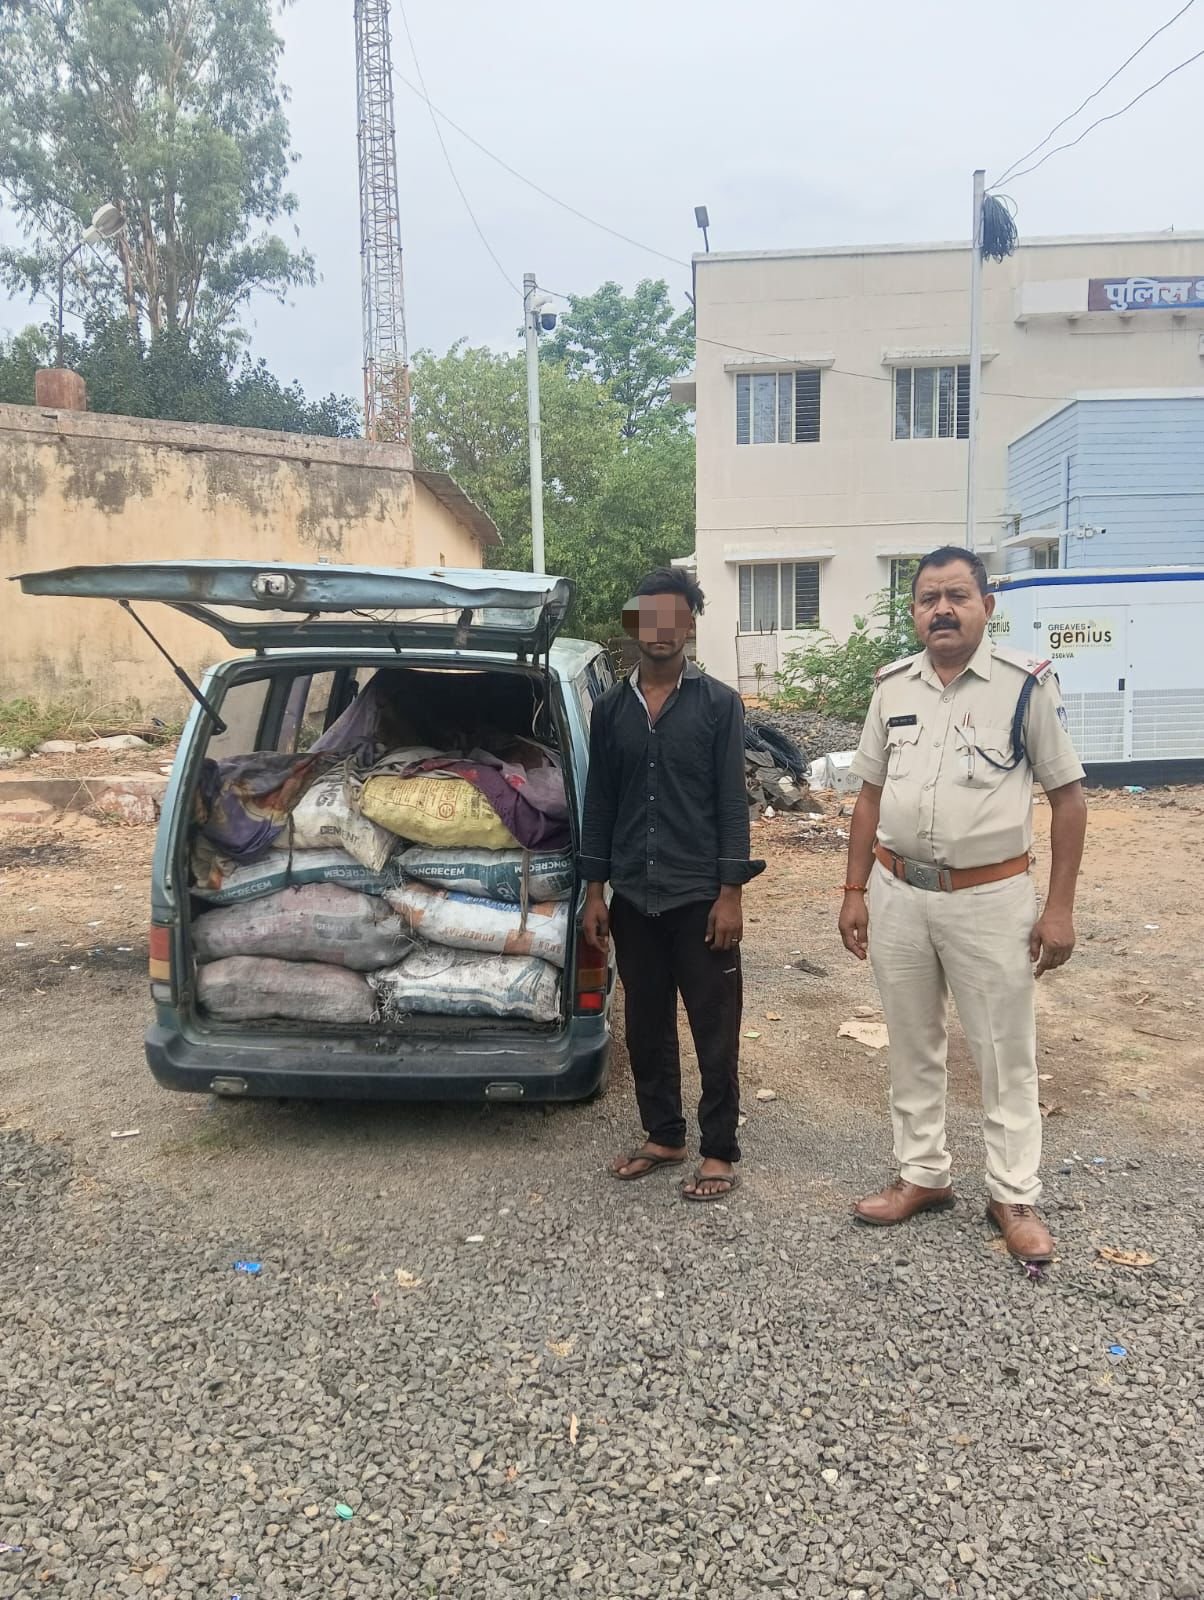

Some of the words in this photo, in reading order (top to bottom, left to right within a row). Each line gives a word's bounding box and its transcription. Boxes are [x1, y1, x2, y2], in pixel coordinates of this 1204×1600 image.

[1103, 277, 1193, 310] पुलिस
[988, 621, 1010, 638] genius
[1050, 625, 1112, 649] genius
[320, 825, 359, 844] CEMENT
[411, 866, 465, 876] ONCRECEM
